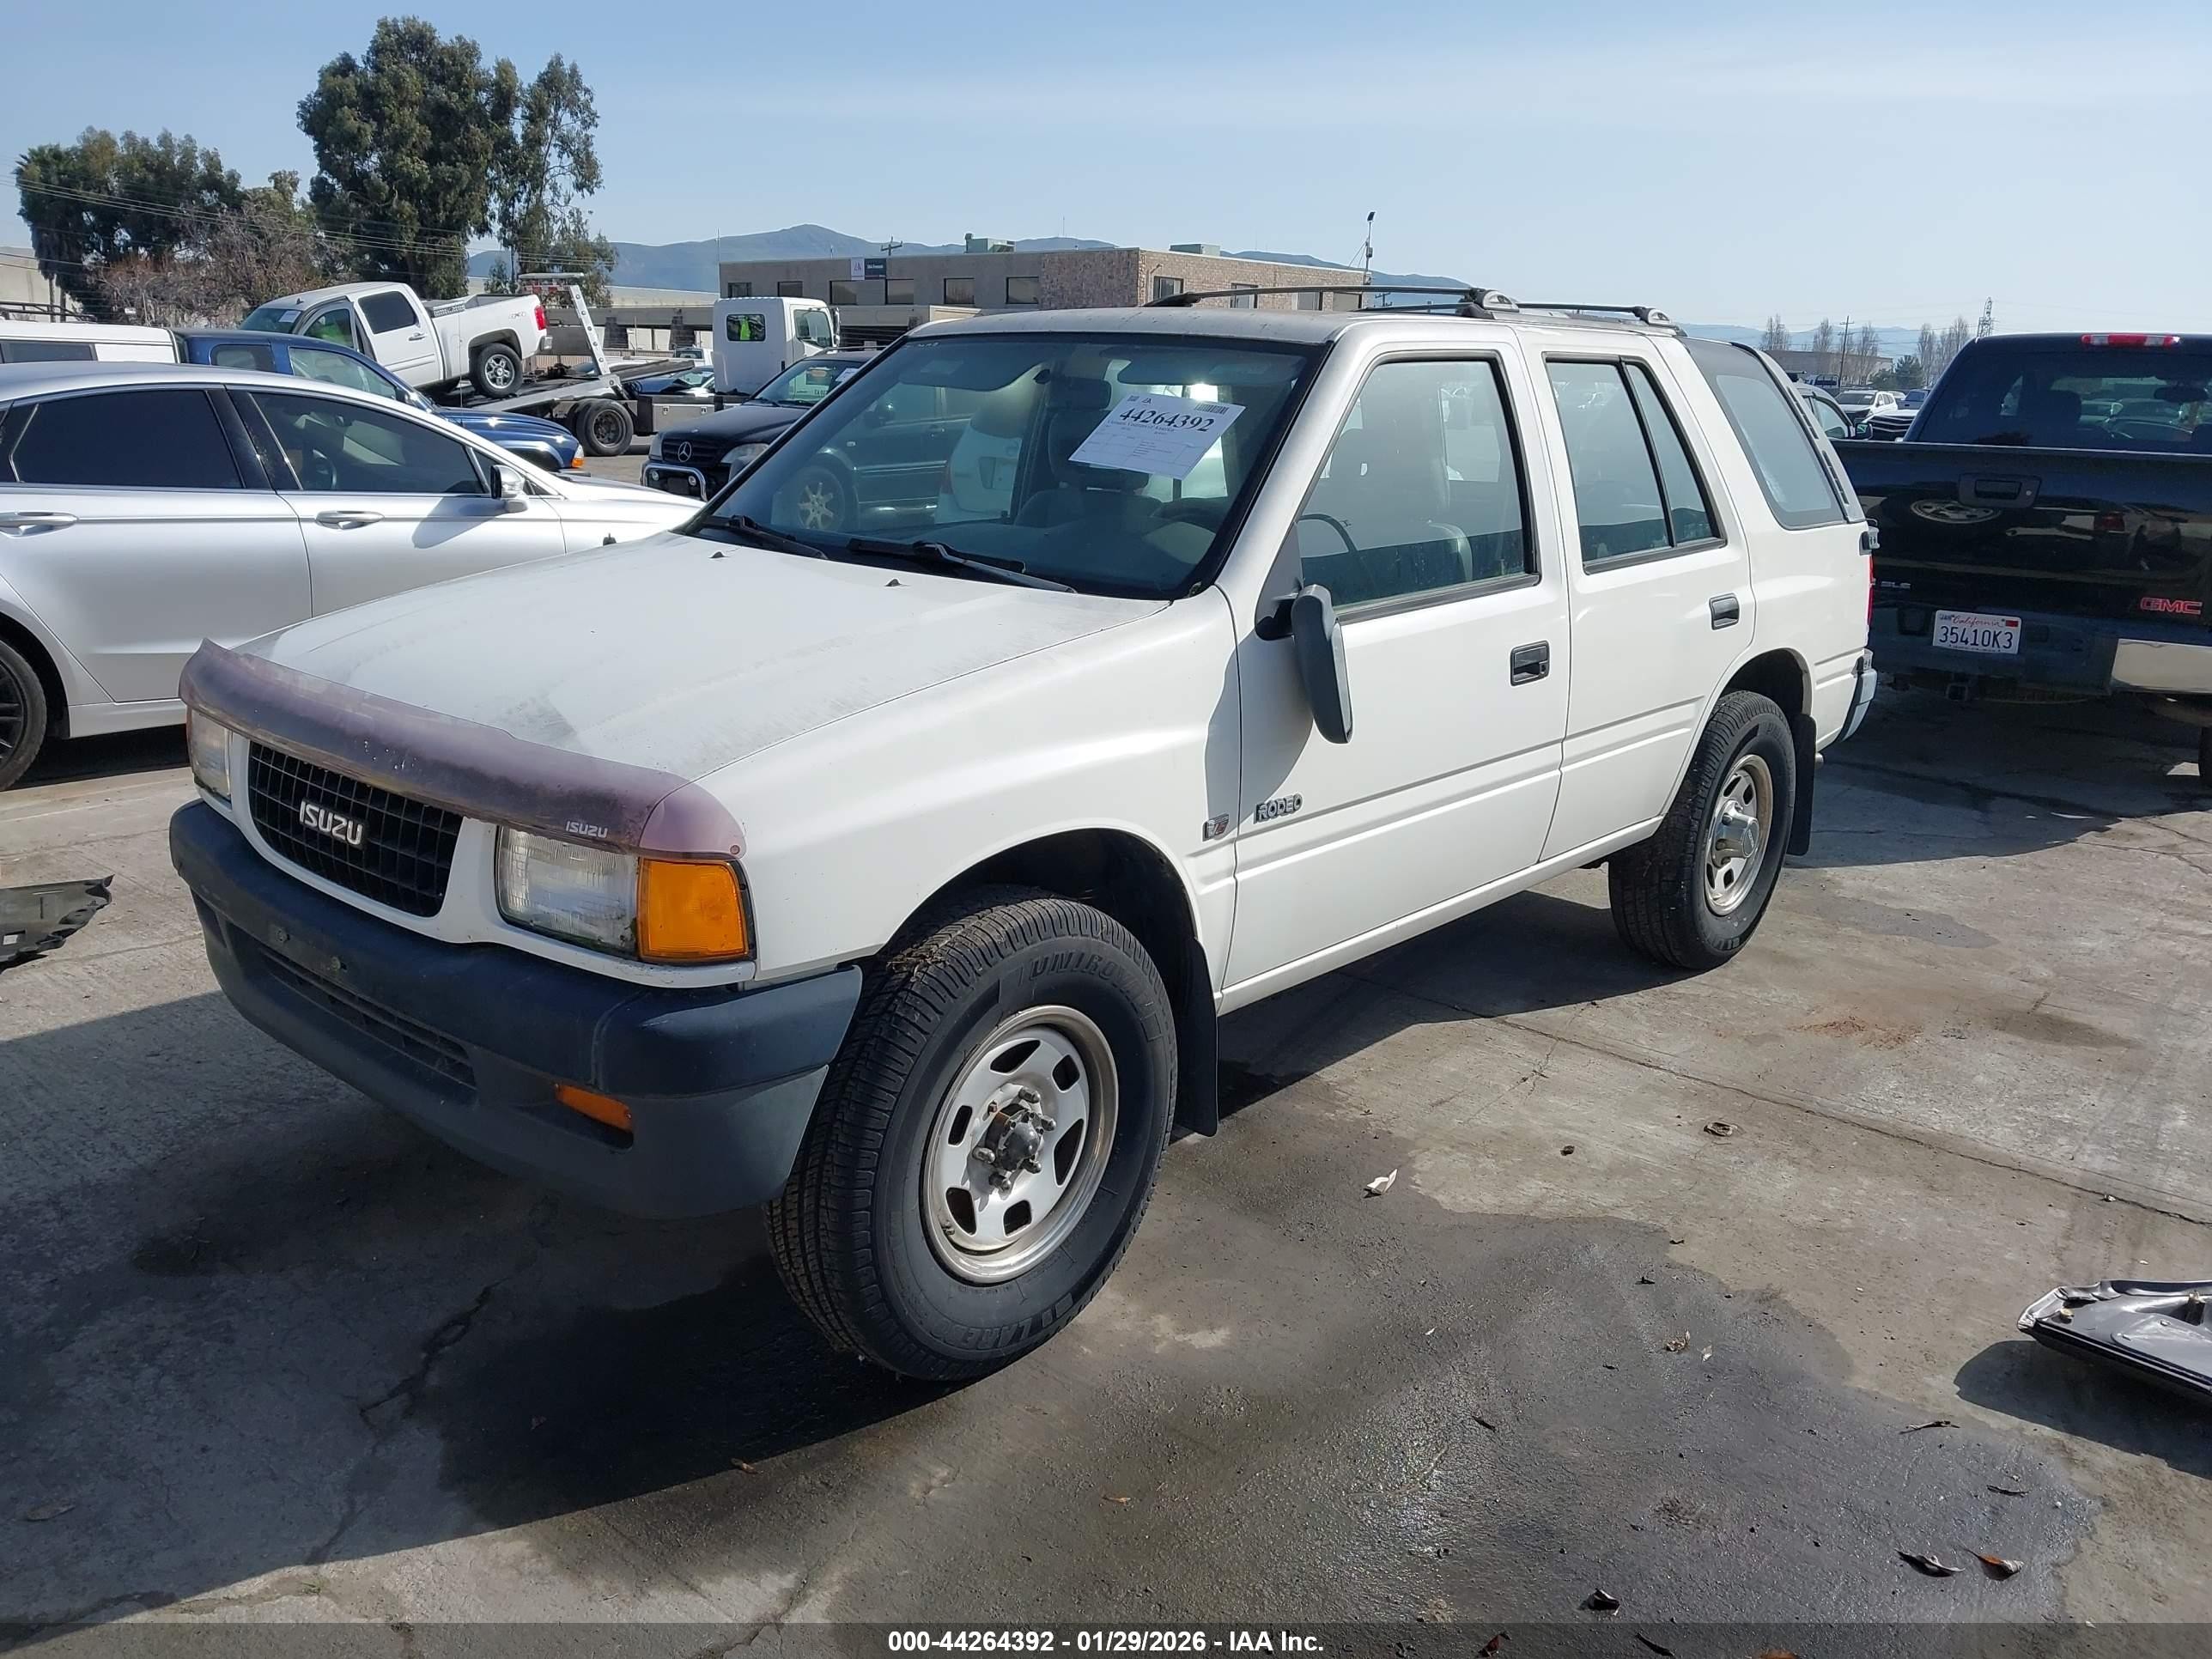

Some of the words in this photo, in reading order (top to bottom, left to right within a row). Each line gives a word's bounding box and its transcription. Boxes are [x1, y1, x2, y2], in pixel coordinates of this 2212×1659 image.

[1119, 407, 1215, 432] 44264392
[2140, 597, 2203, 616] GMC
[1952, 614, 2004, 629] California
[1939, 625, 2014, 650] 35410K3
[1255, 793, 1304, 823] RODEO
[299, 800, 363, 845] ISUZU
[565, 820, 609, 838] ISUZU
